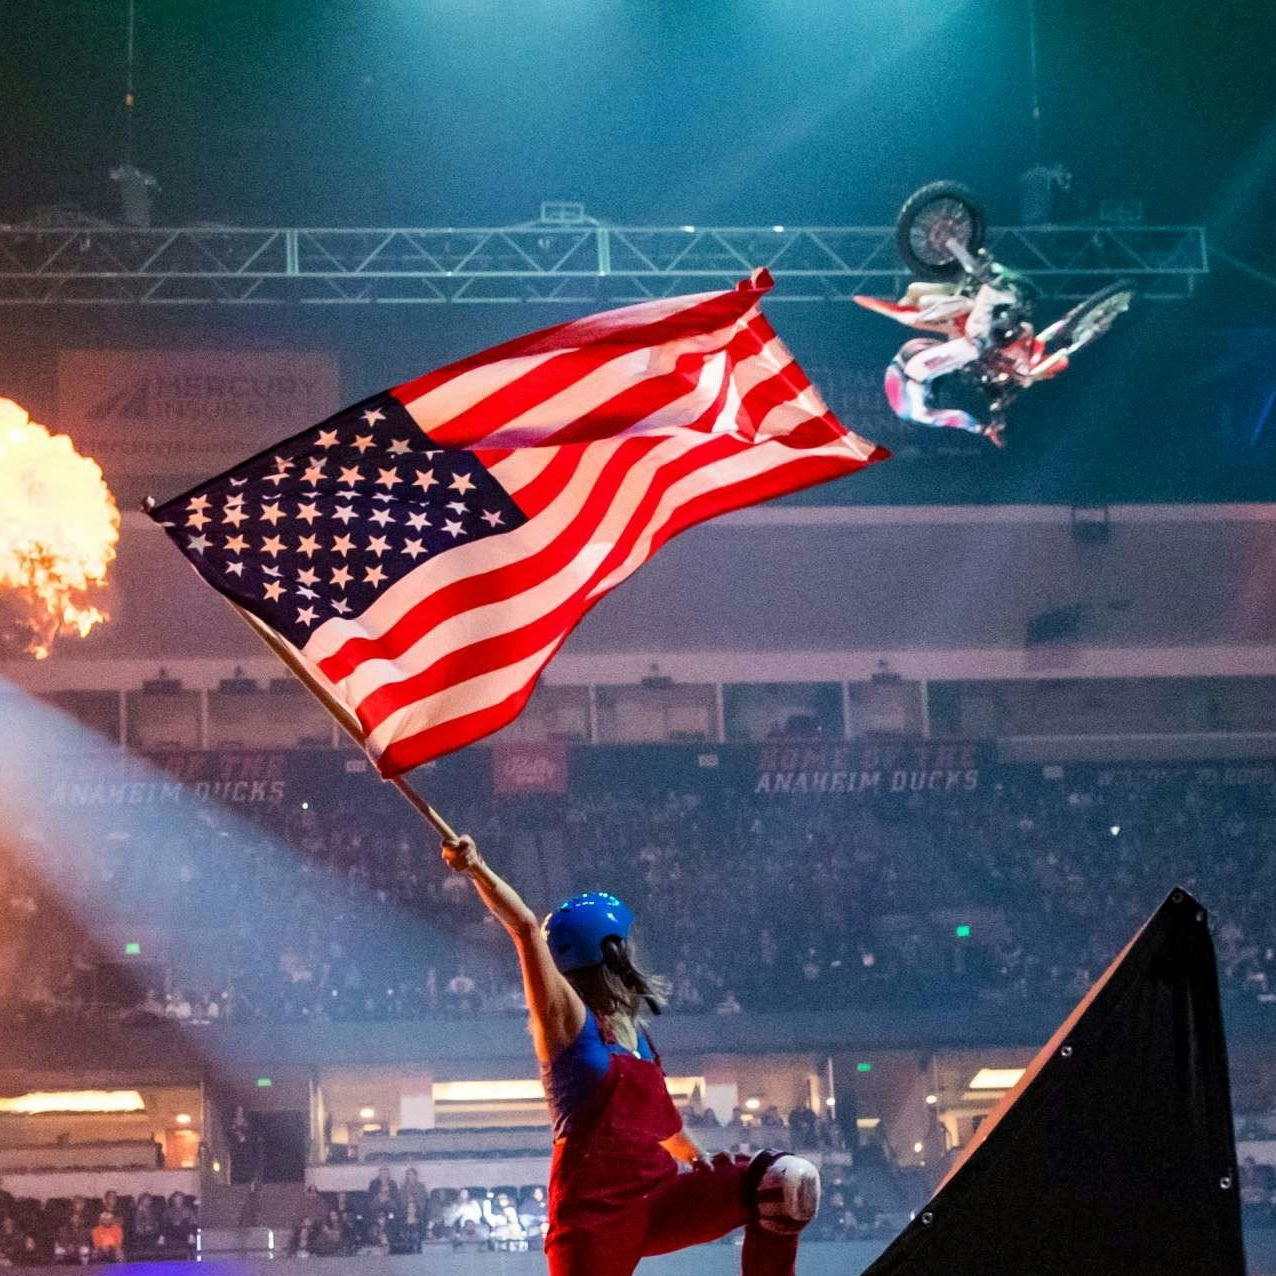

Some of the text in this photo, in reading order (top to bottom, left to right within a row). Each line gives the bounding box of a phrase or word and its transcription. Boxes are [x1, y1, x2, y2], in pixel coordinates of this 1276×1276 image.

[156, 376, 323, 397] MERCURY
[48, 780, 286, 805] ANAHEIM DUCKS
[755, 769, 979, 793] ANAHEIM DUCKS
